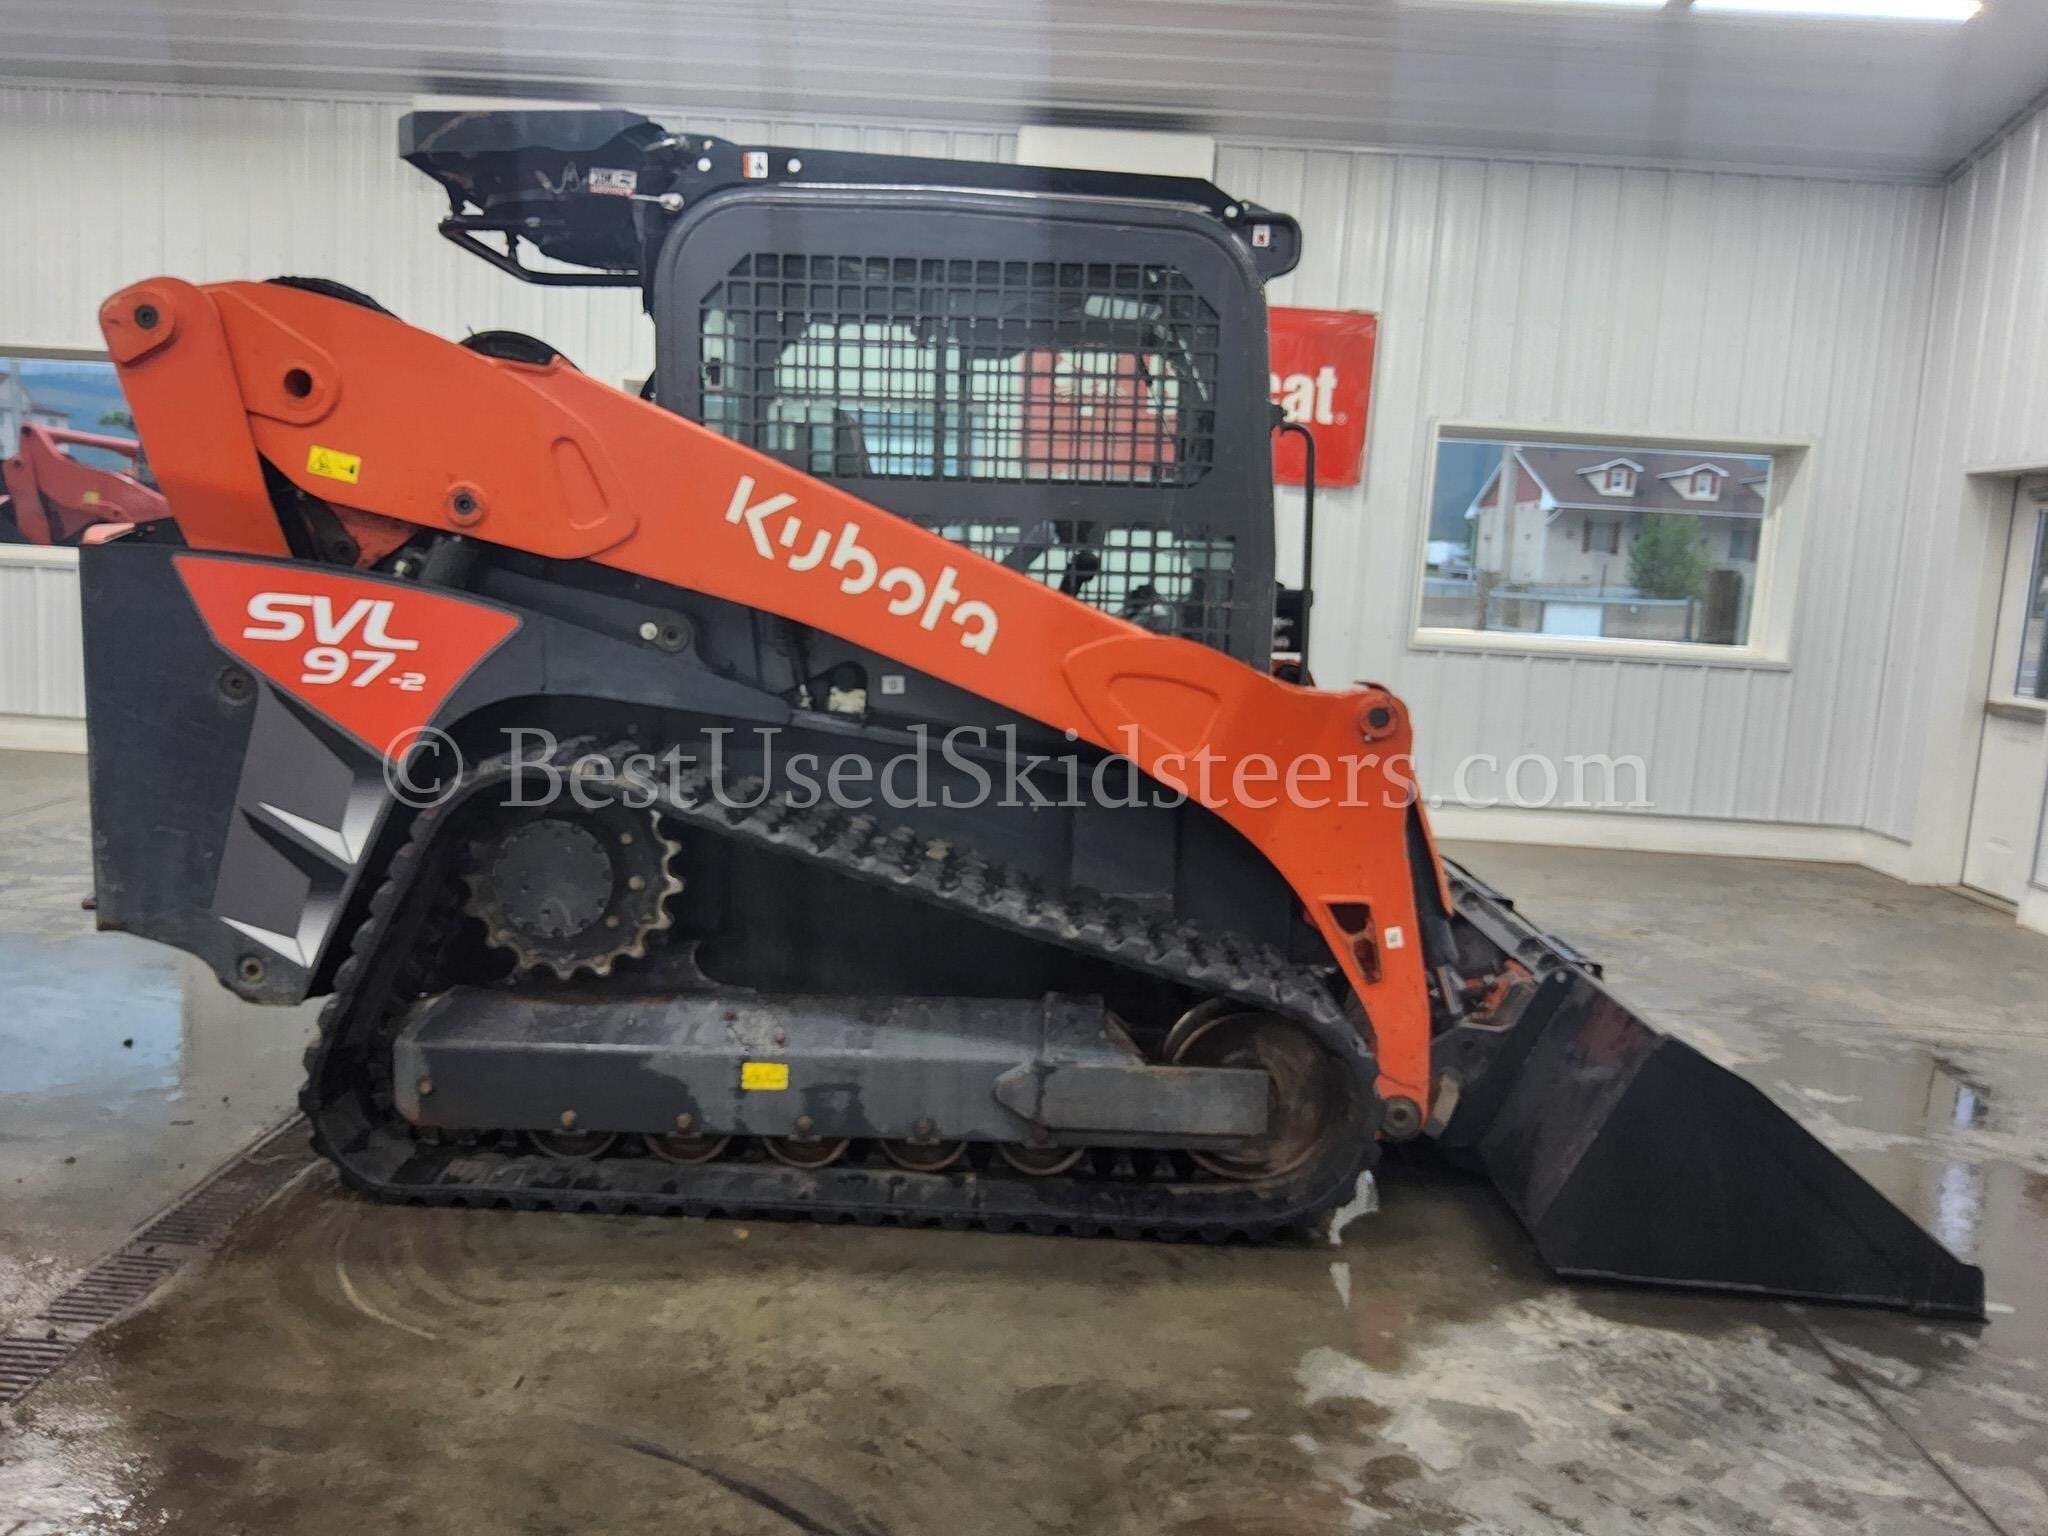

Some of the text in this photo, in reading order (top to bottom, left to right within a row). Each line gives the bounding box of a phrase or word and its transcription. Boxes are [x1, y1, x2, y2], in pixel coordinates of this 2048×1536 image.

[725, 475, 998, 656] Kubota
[242, 592, 420, 651] SVL
[301, 646, 427, 692] 97-2
